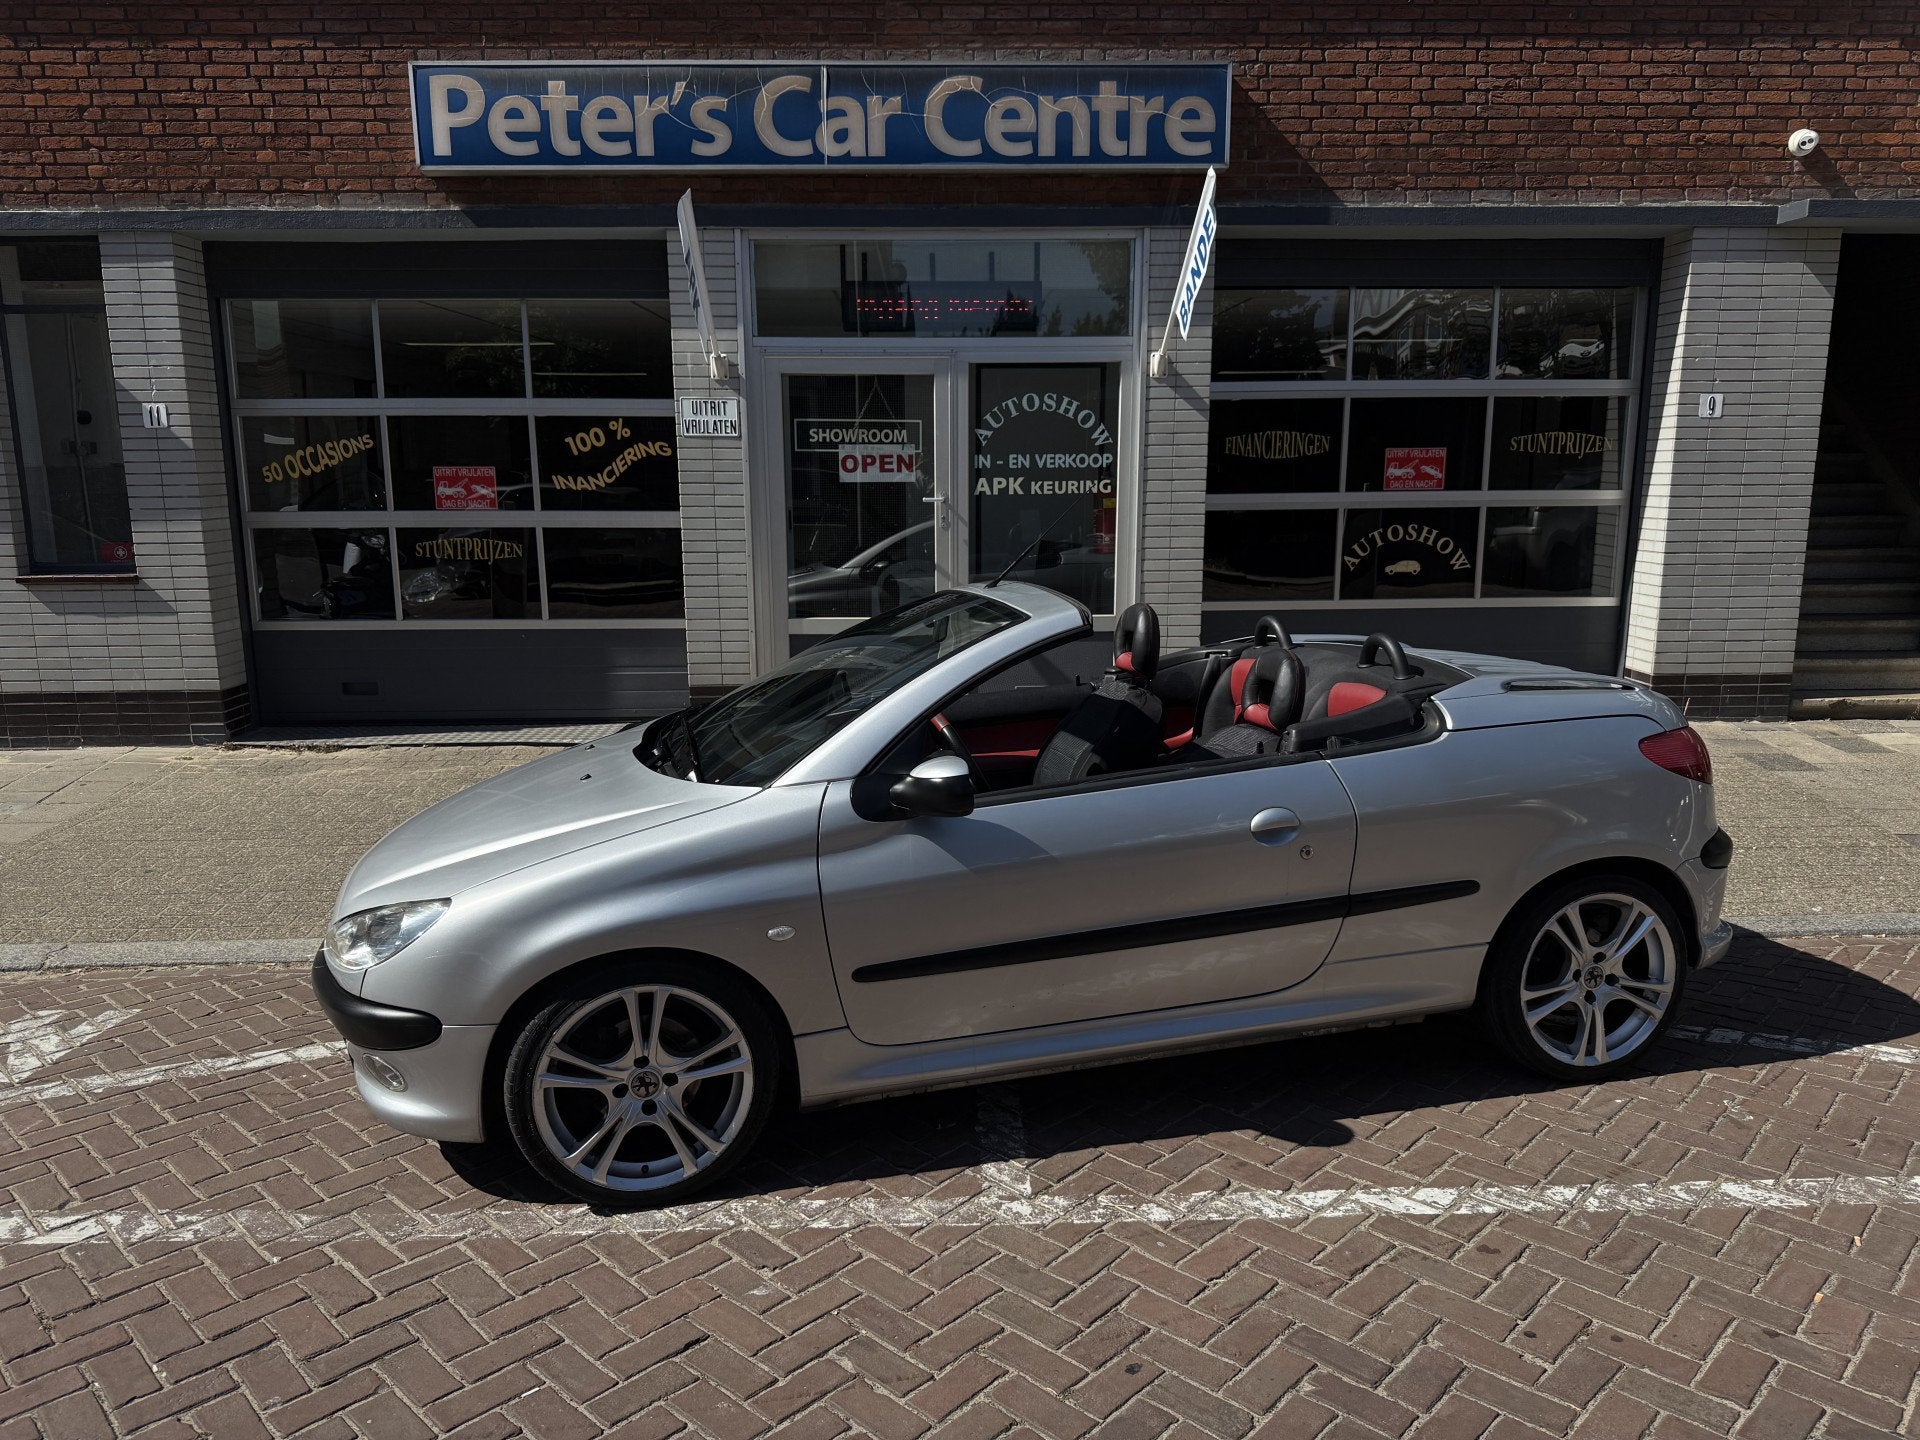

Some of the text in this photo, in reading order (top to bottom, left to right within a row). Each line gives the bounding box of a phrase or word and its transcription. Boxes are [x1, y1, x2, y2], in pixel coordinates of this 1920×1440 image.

[428, 74, 1217, 157] Peter's Car Centre
[148, 405, 161, 427] 11
[691, 400, 728, 416] UITRIT
[1708, 396, 1716, 416] 9
[683, 419, 737, 434] VRIJLATEN
[974, 392, 1114, 447] AUTOSHOW
[564, 418, 631, 456] 100 %
[809, 428, 907, 443] SHOWROOM
[1224, 430, 1331, 459] FINANCIERINGEN
[1509, 431, 1613, 460] STUNTPRIJZEN
[262, 434, 374, 483] 50 OCCASIONS
[974, 453, 991, 469] IN
[1008, 453, 1030, 469] EN
[1035, 453, 1113, 469] VERKOOP
[1388, 449, 1444, 458] UITRIT VRIJLATEN
[434, 468, 494, 477] UITRIT VRIJLATEN
[551, 441, 673, 490] INANCIERING
[840, 454, 914, 474] OPEN
[974, 476, 1113, 496] APK KEURING
[1390, 479, 1438, 489] DAG EN NACHT
[442, 499, 491, 508] DAG EN NACHT
[415, 537, 523, 565] STUNTPRIJZEN
[1343, 523, 1471, 572] AUTOSHOW
